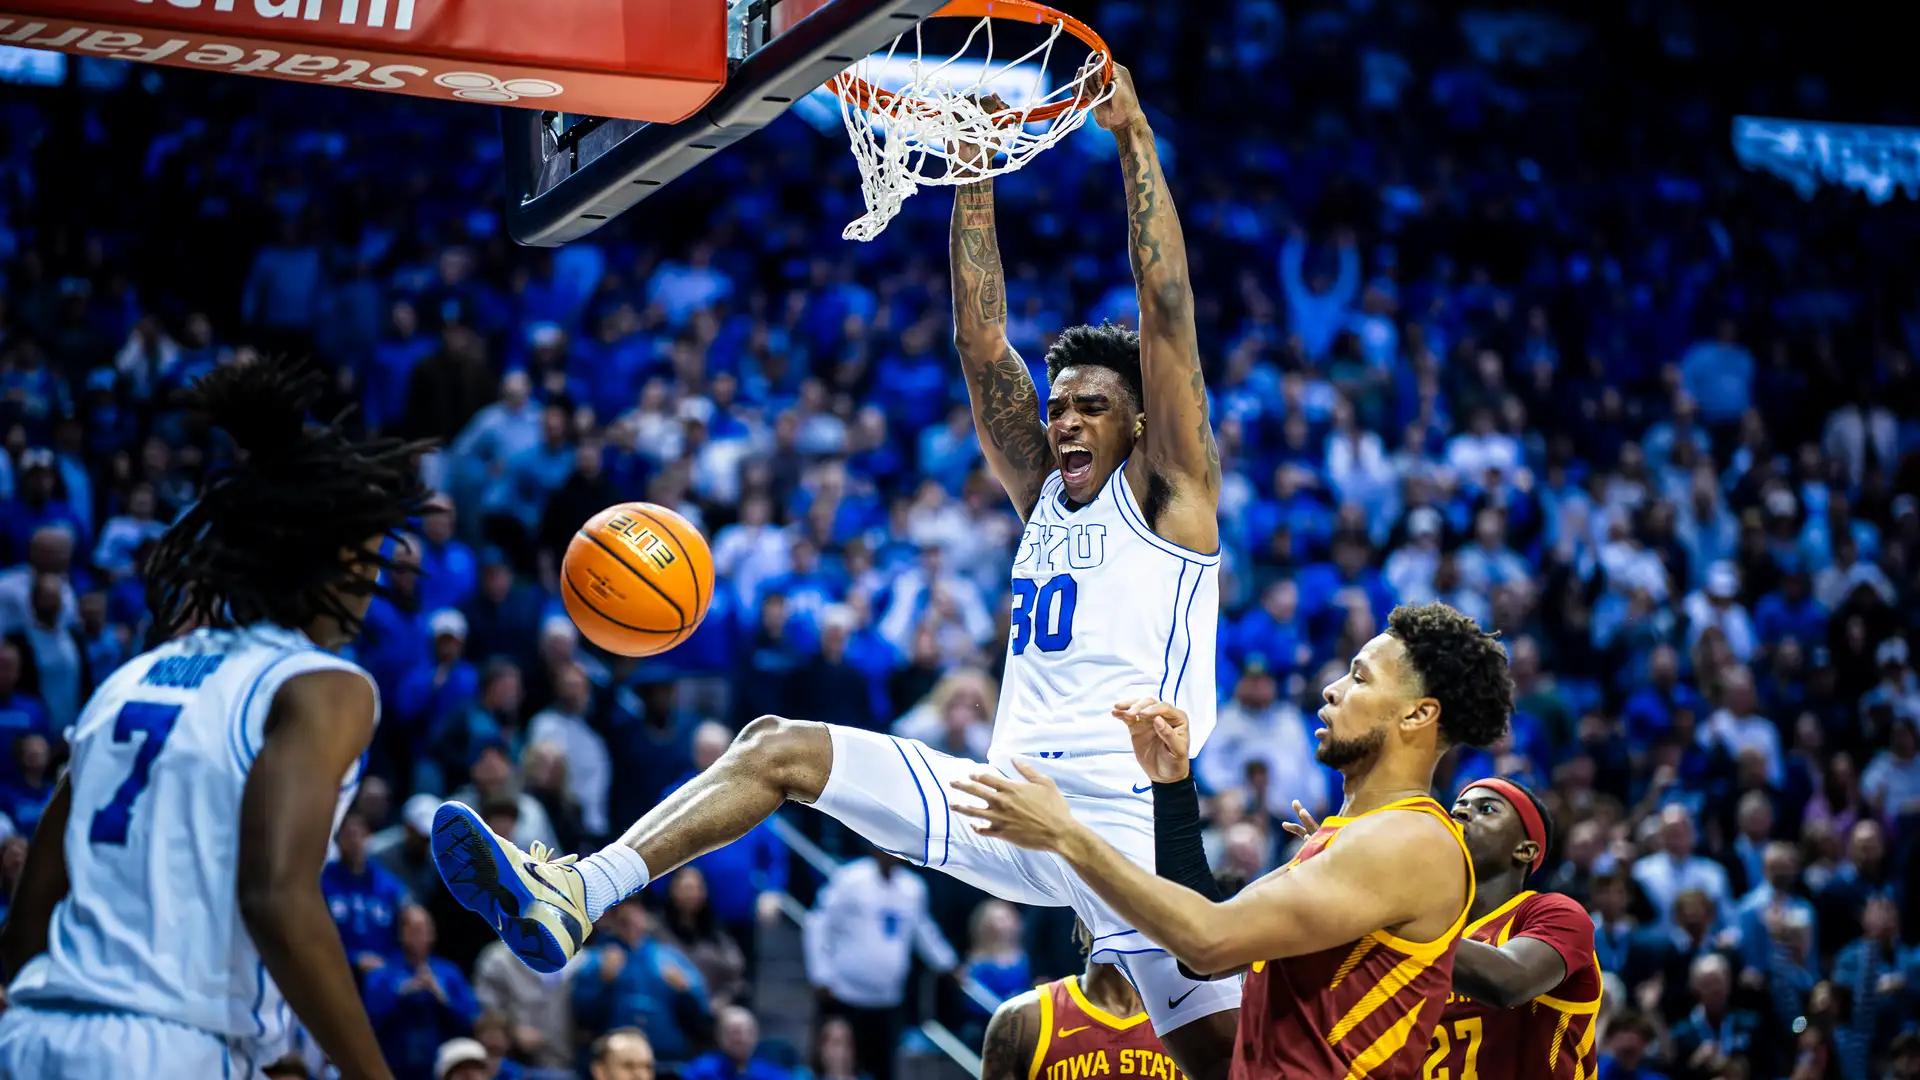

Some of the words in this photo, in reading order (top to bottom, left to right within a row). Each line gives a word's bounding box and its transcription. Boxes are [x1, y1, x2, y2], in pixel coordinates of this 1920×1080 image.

[606, 511, 678, 571] ELITE
[1011, 573, 1078, 656] 30
[89, 701, 183, 845] 7
[1046, 1050, 1110, 1080] IOWA
[1422, 1016, 1483, 1080] 27
